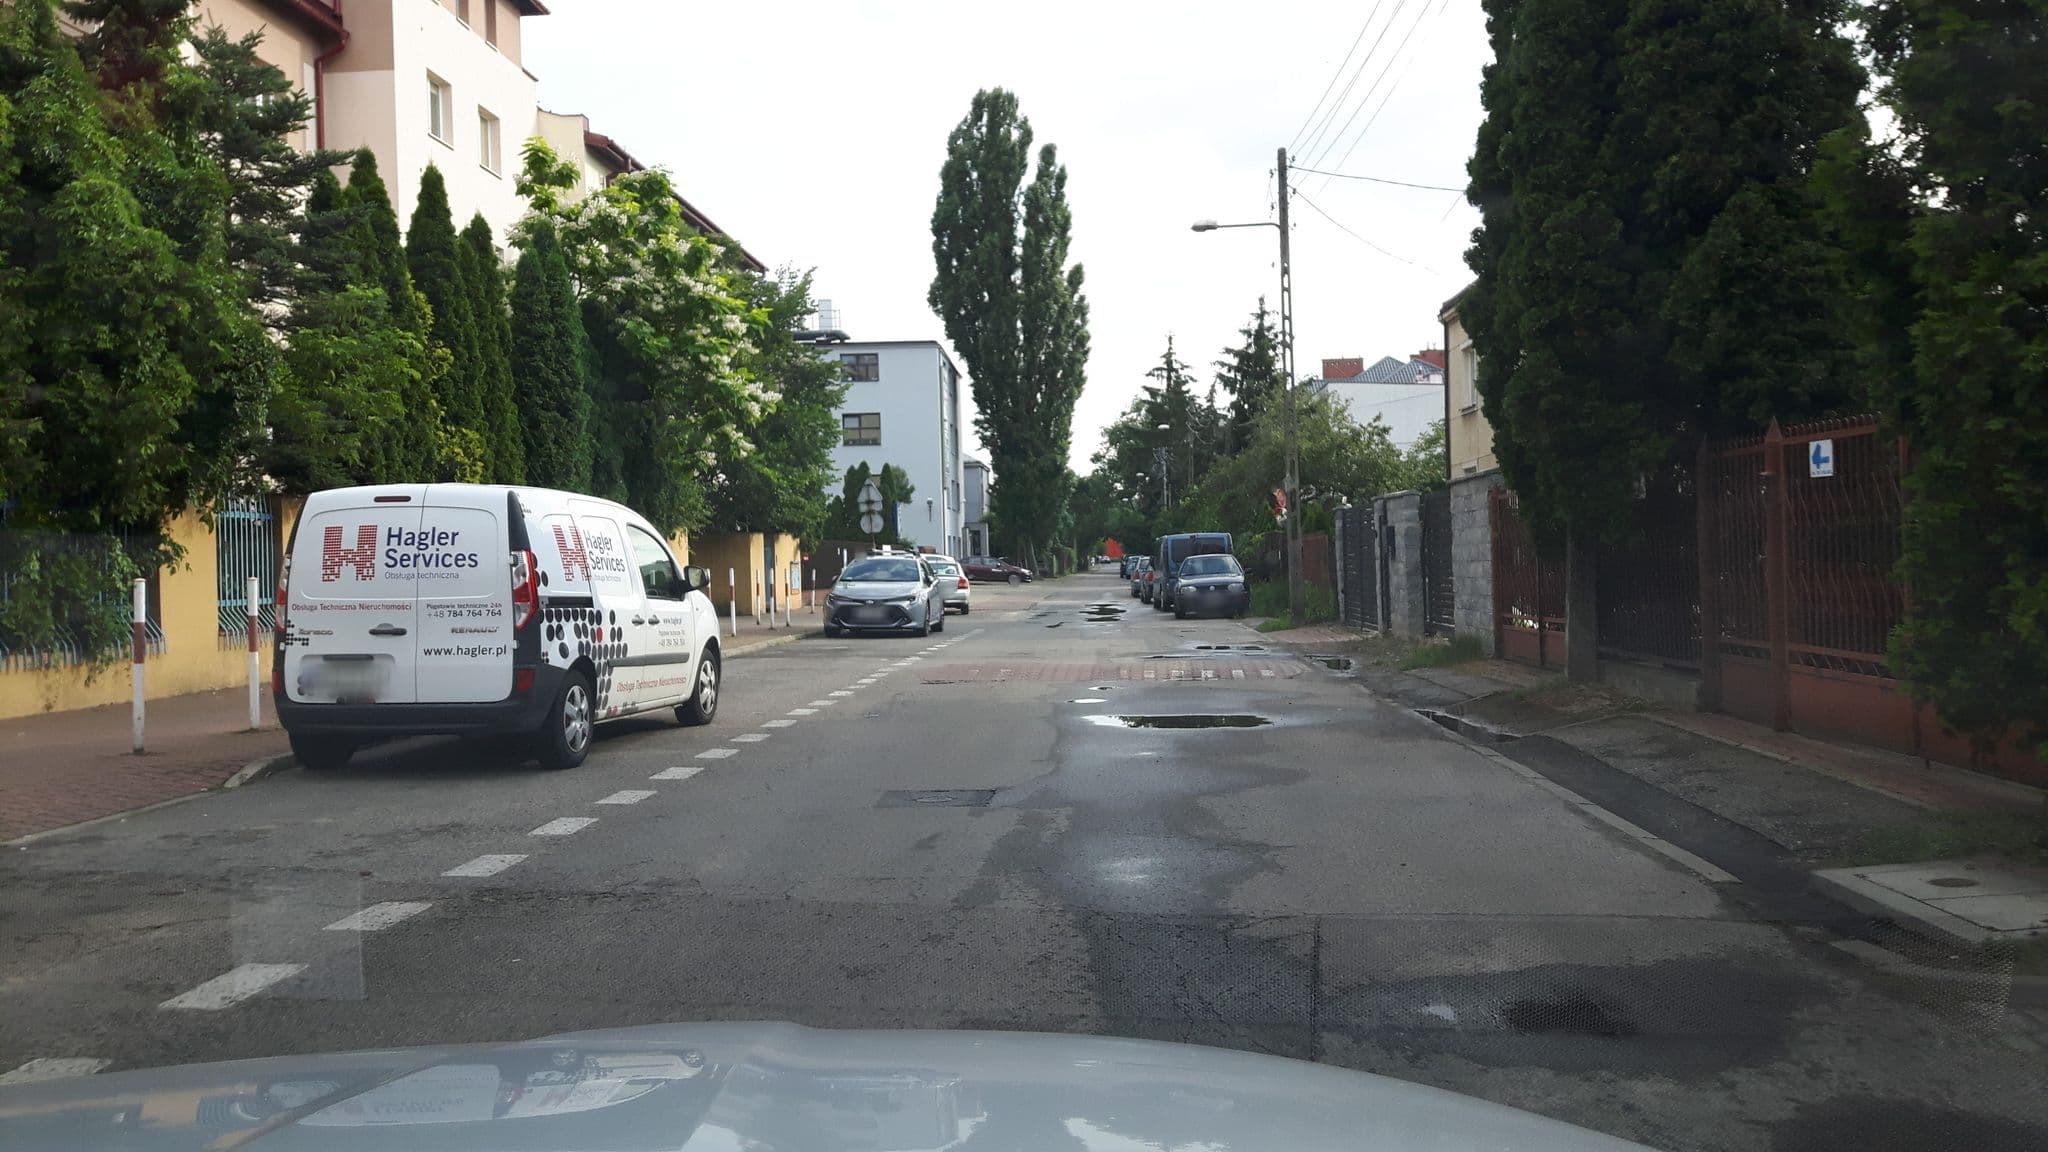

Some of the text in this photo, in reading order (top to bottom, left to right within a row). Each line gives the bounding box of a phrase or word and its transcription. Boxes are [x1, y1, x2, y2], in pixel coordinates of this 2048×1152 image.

[386, 526, 460, 551] Hagler
[583, 529, 613, 554] Hagler
[384, 547, 478, 568] Services
[589, 551, 625, 572] Services
[385, 571, 460, 581] Obsługa techniczna
[320, 603, 357, 611] Techniczna
[359, 601, 412, 610] Nieruchomości
[426, 609, 502, 618] +48 784 764 764
[423, 644, 507, 658] www.hagler.pl
